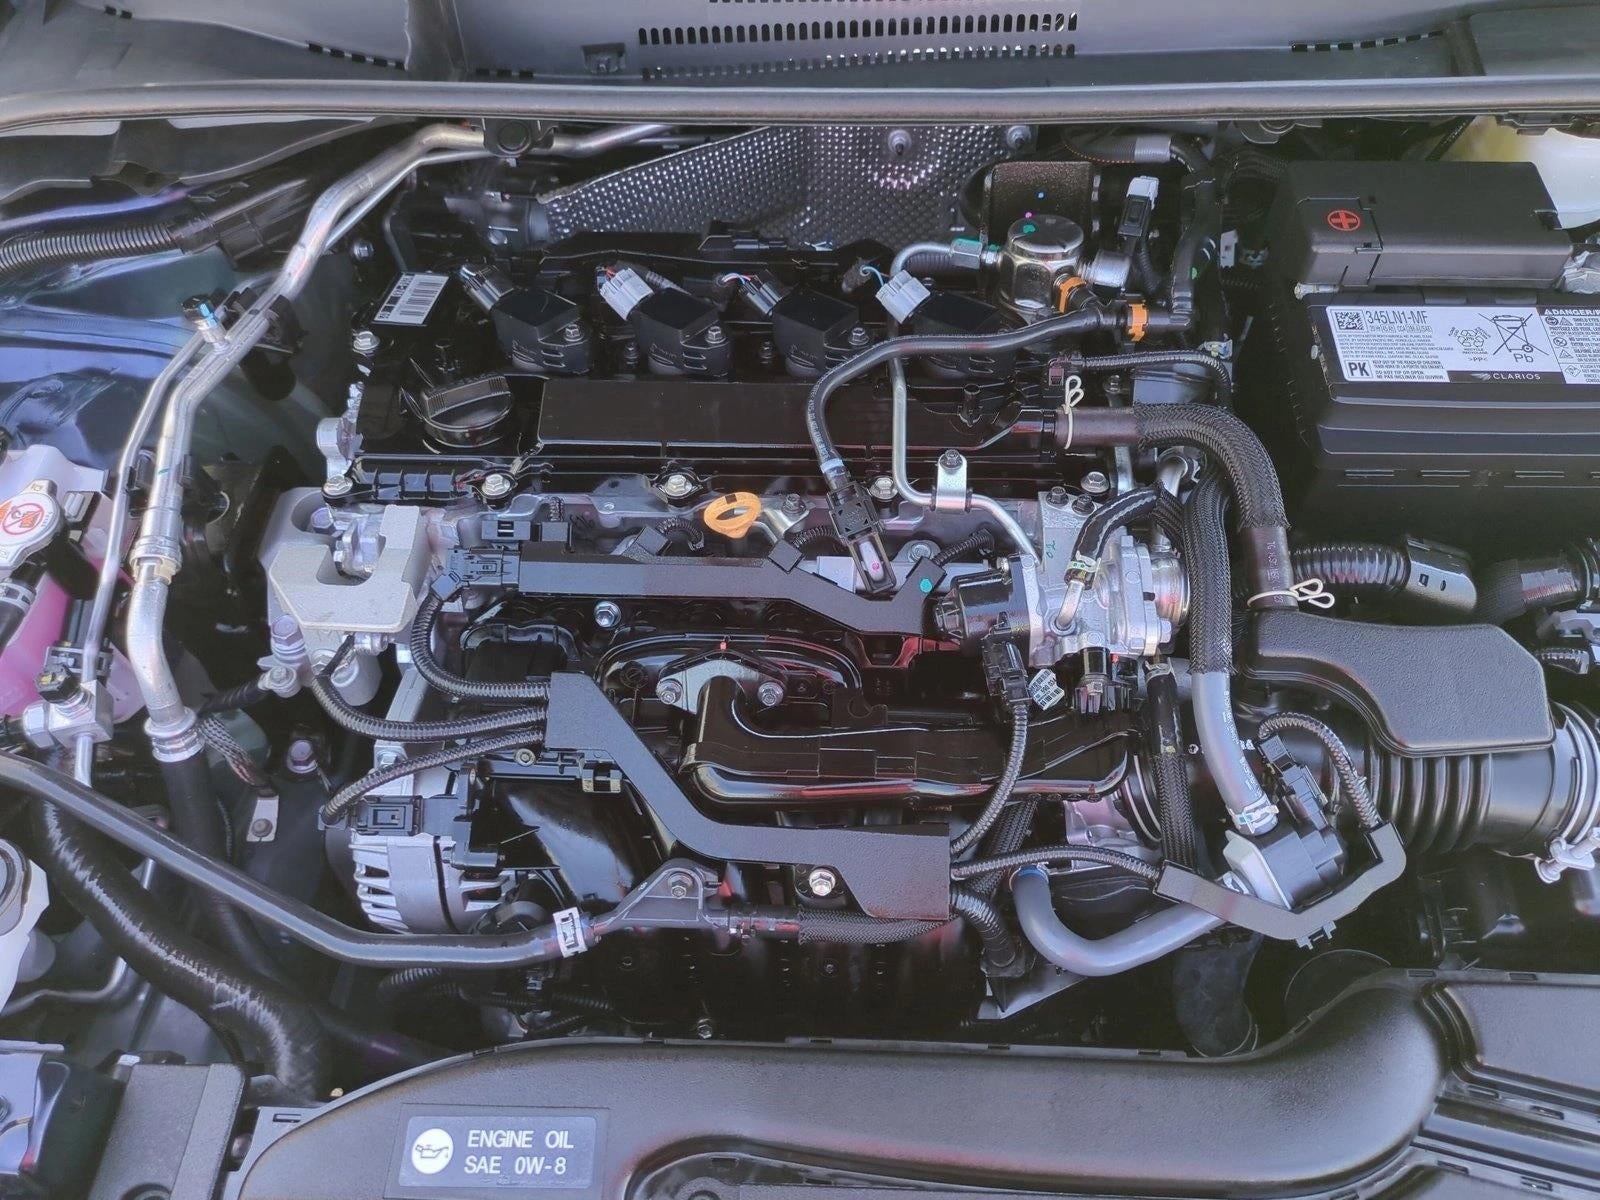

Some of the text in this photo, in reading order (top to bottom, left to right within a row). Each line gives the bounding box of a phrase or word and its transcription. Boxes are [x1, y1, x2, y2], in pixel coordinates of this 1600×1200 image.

[1365, 310, 1428, 324] 345LN1-MF
[1513, 353, 1534, 363] Pb
[1348, 362, 1369, 376] PK
[467, 1130, 574, 1149] ENGINE OIL
[464, 1155, 567, 1175] SAE 0W-8
